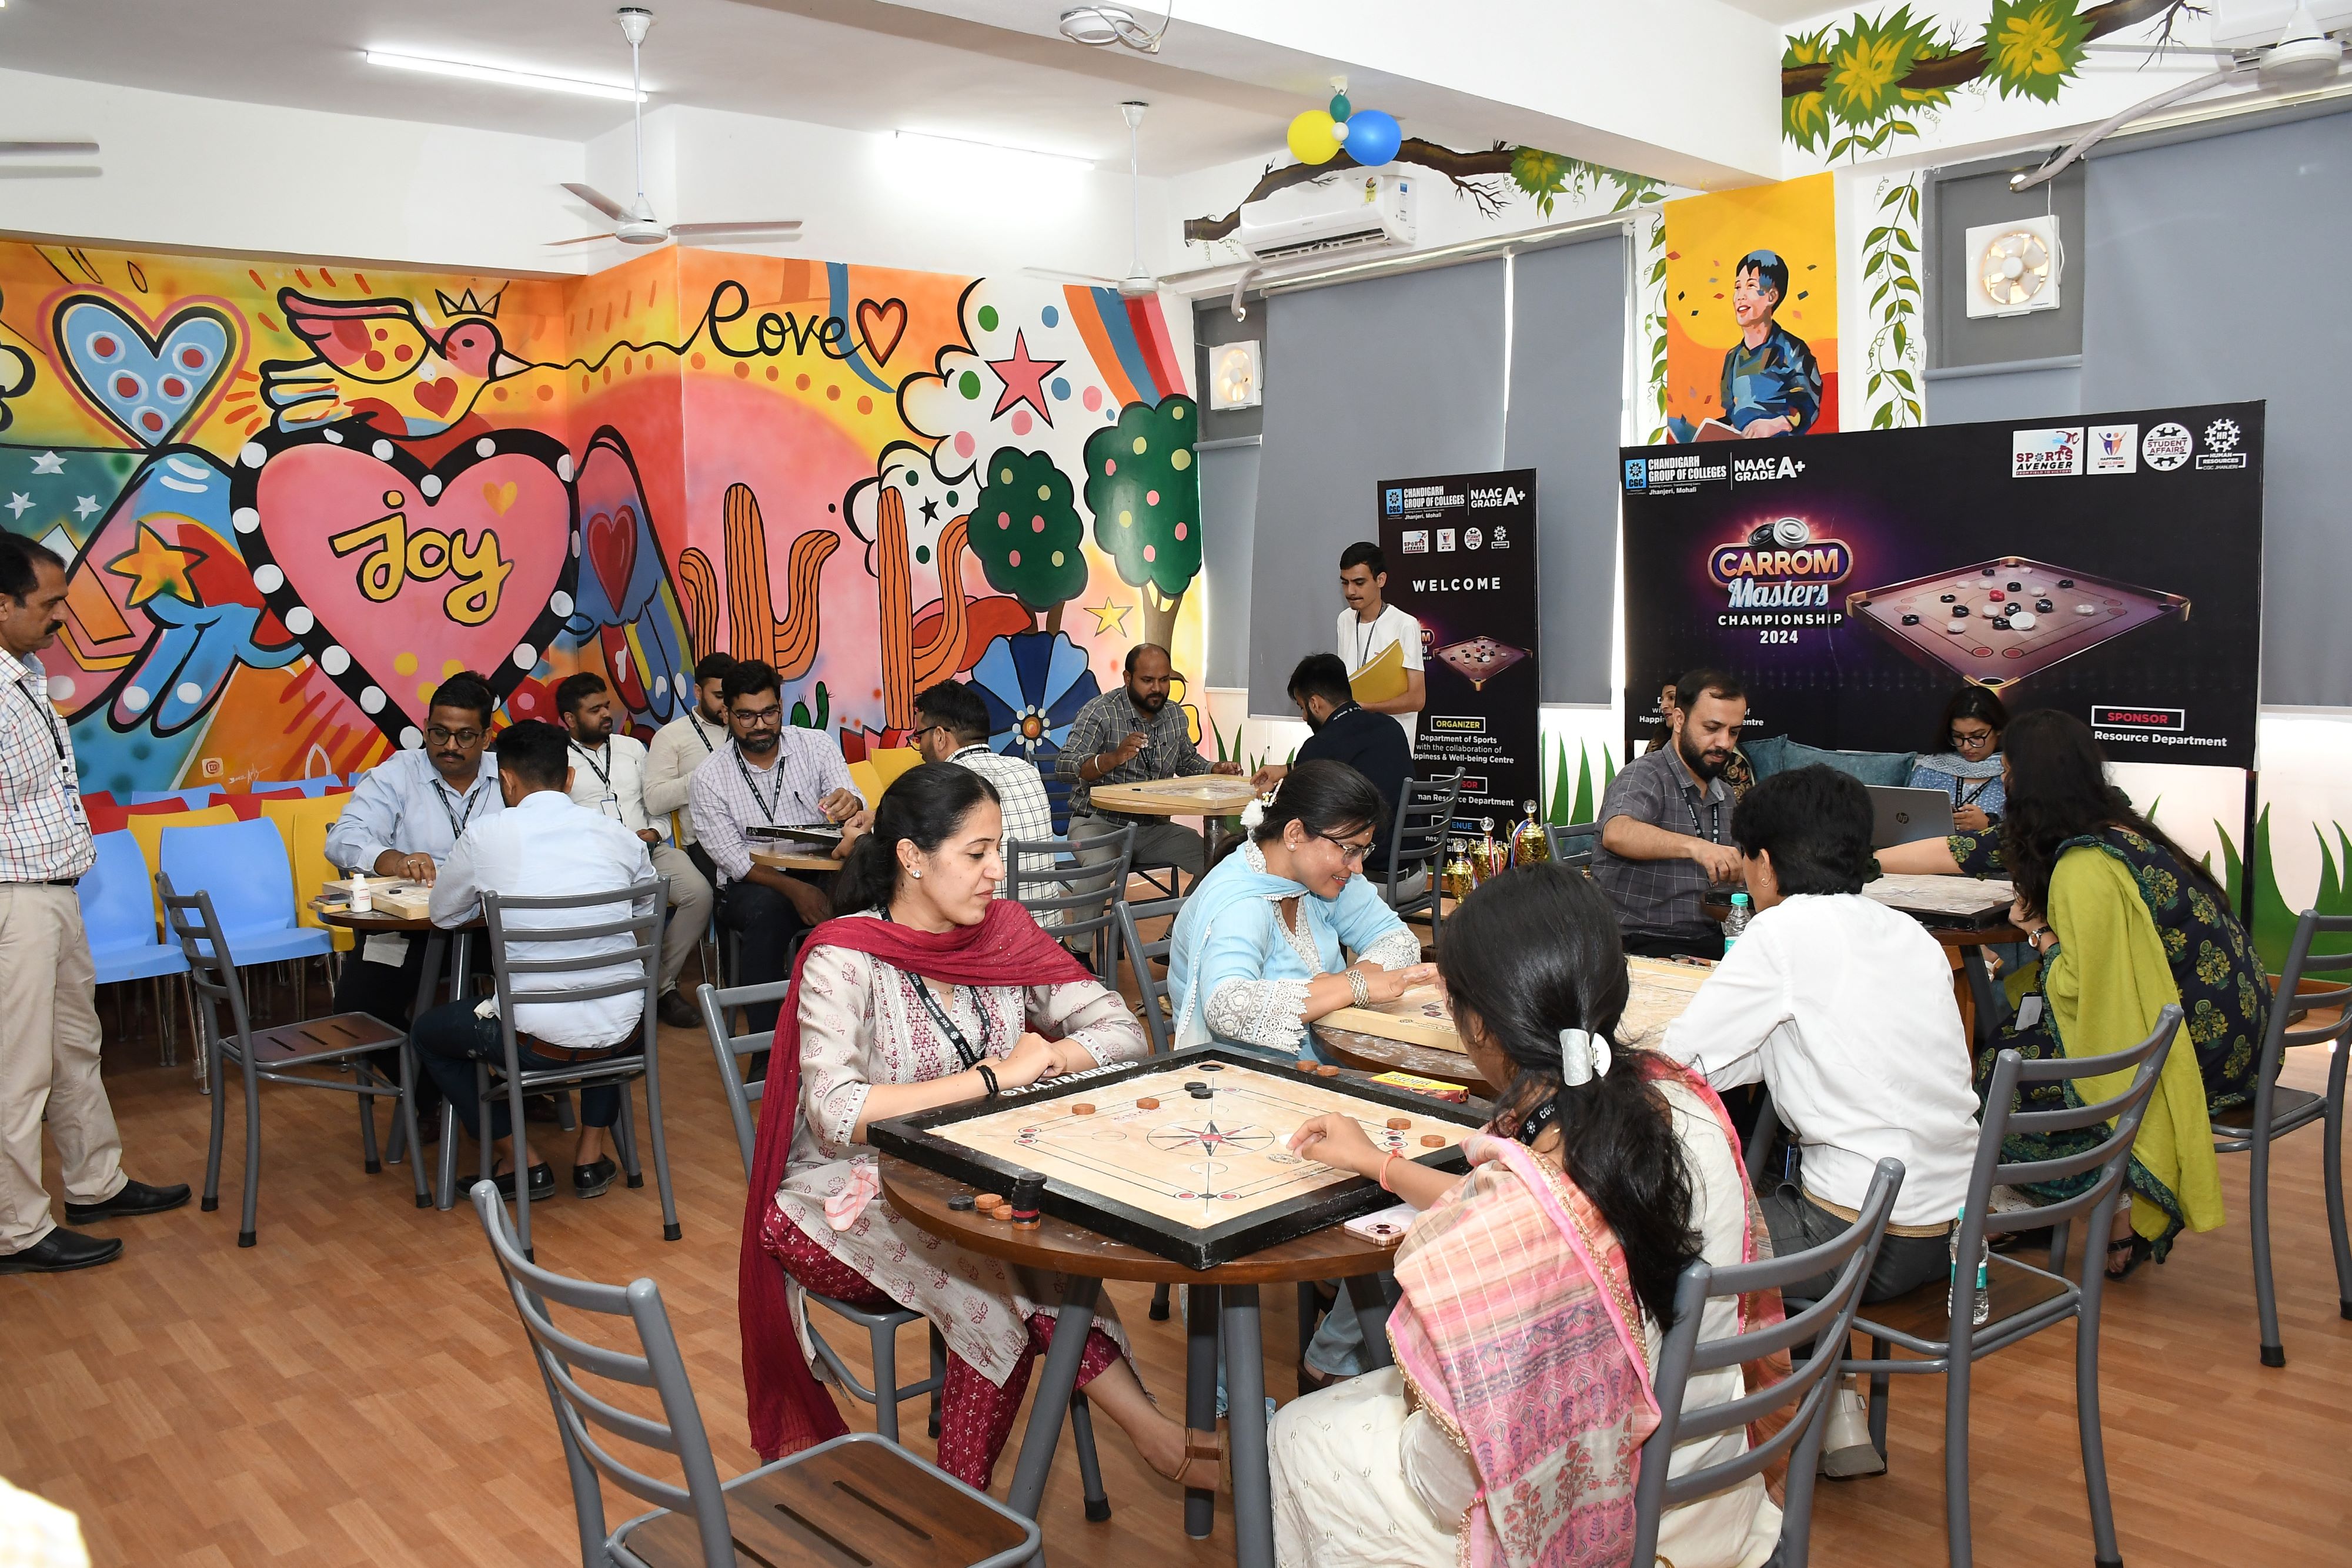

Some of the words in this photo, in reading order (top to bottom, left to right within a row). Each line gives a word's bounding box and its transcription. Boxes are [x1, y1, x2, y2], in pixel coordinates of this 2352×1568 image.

[2217, 432, 2227, 440] HR
[2147, 440, 2187, 448] STUDENT
[1648, 456, 1700, 470] CHANDIGARH
[1735, 458, 1775, 472] NAAC
[1735, 471, 1775, 482] GRADE
[1776, 456, 1806, 479] A+
[2016, 462, 2073, 470] AVENGER
[1648, 469, 1676, 482] GROUP
[1677, 469, 1687, 481] OF
[1688, 465, 1726, 480] COLLEGES
[1628, 479, 1643, 487] CGC
[1404, 486, 1444, 499] CHANDIGARH
[1471, 488, 1502, 500] NAAC
[1471, 499, 1502, 509] GRADE
[1503, 487, 1526, 506] A+
[1404, 497, 1425, 509] GROUP
[1426, 496, 1434, 507] OF
[1435, 494, 1465, 506] COLLEGES
[1719, 548, 1839, 576] CARROM
[1412, 577, 1501, 593] WELCOME
[1728, 577, 1829, 608] Masters
[1718, 613, 1842, 626] CHAMPIONSHIP
[1759, 630, 1799, 644] 2024
[1436, 720, 1480, 729] ORGANIZER
[2107, 712, 2169, 724] SPONSOR
[1420, 734, 1462, 743] Department
[1473, 736, 1497, 744] Sports
[2094, 731, 2149, 743] Resource
[2152, 734, 2227, 747] Department
[1445, 744, 1492, 753] collaboration
[1413, 753, 1441, 761] ppiness
[1449, 754, 1488, 764] Well-being
[1489, 755, 1514, 764] Centre
[1468, 797, 1515, 807] Department
[924, 997, 943, 1018] JHANJERI
[940, 1017, 950, 1028] CGC
[958, 1043, 973, 1064] JHANJERI
[1539, 1104, 1555, 1119] CGC
